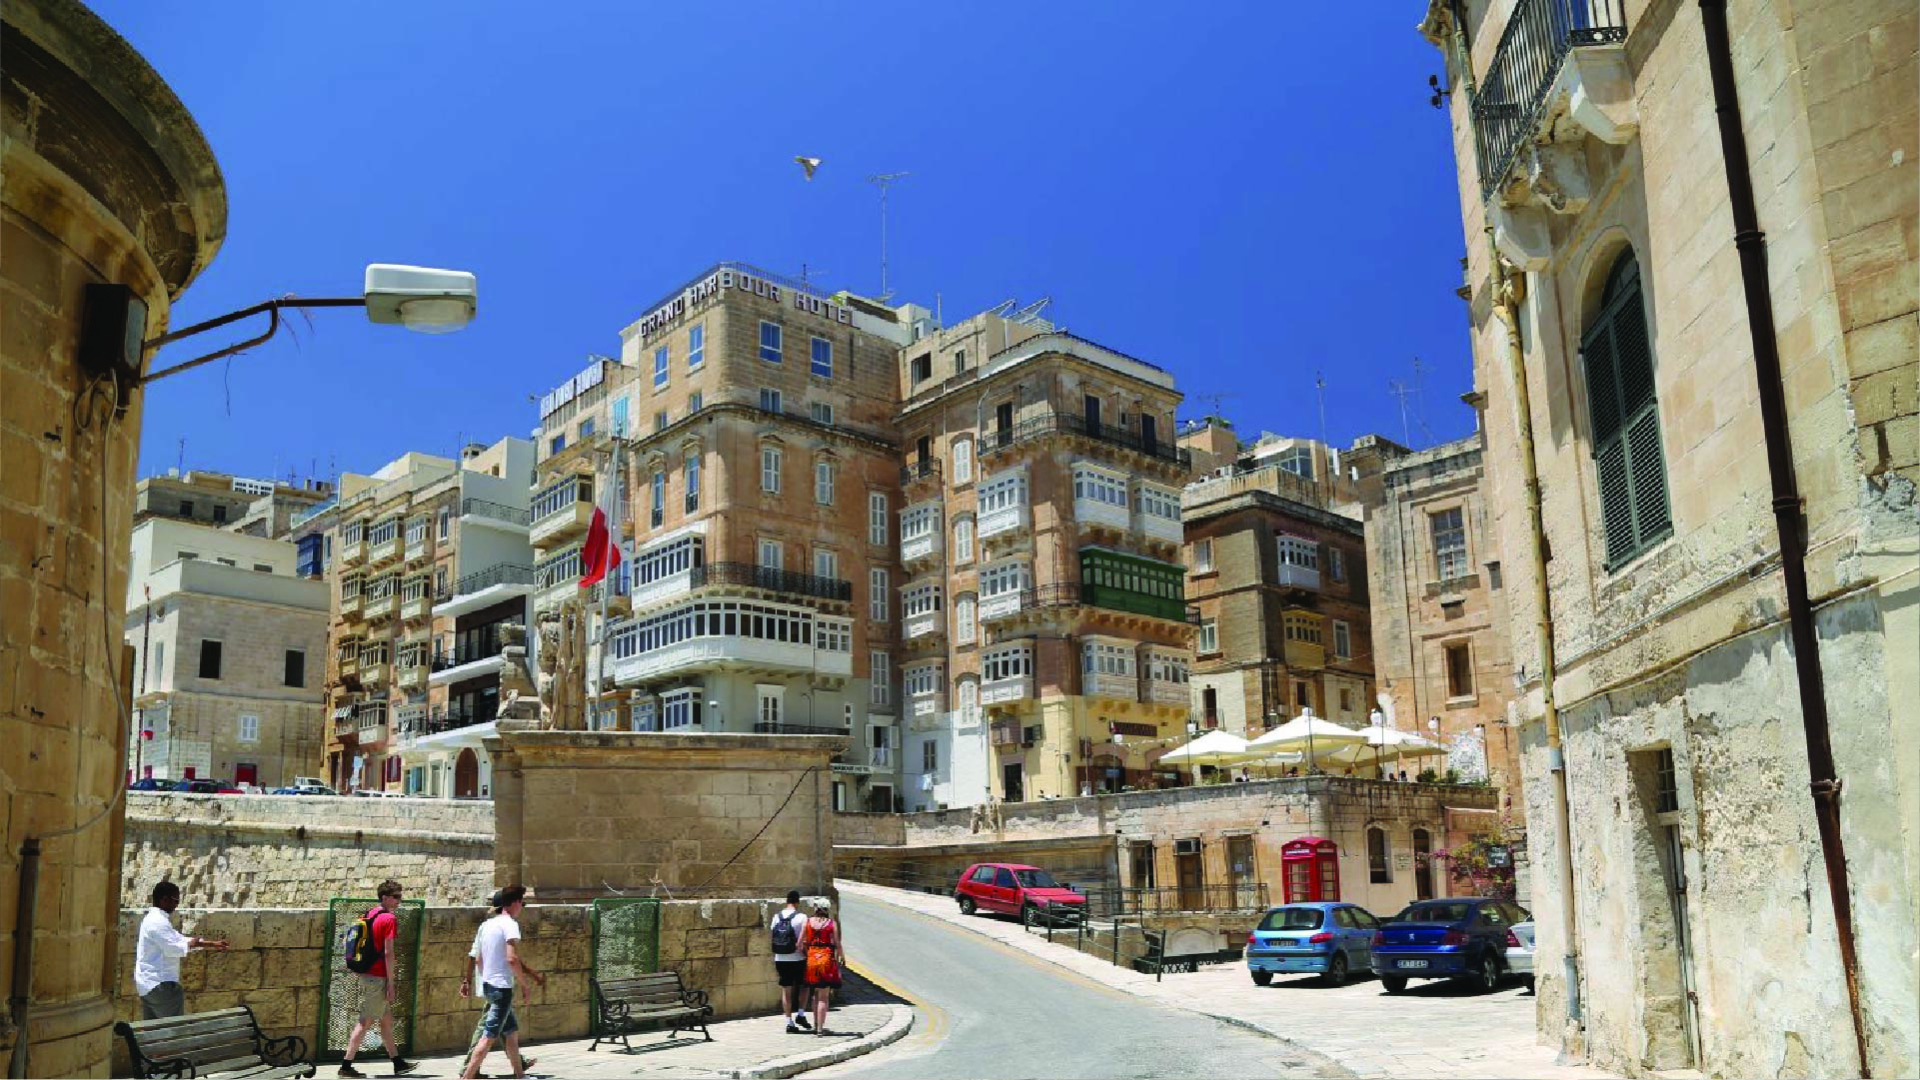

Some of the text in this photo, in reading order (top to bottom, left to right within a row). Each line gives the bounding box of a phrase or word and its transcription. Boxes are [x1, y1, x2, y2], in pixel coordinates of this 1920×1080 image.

[640, 270, 861, 338] GRAND HARBOUR HOTEL
